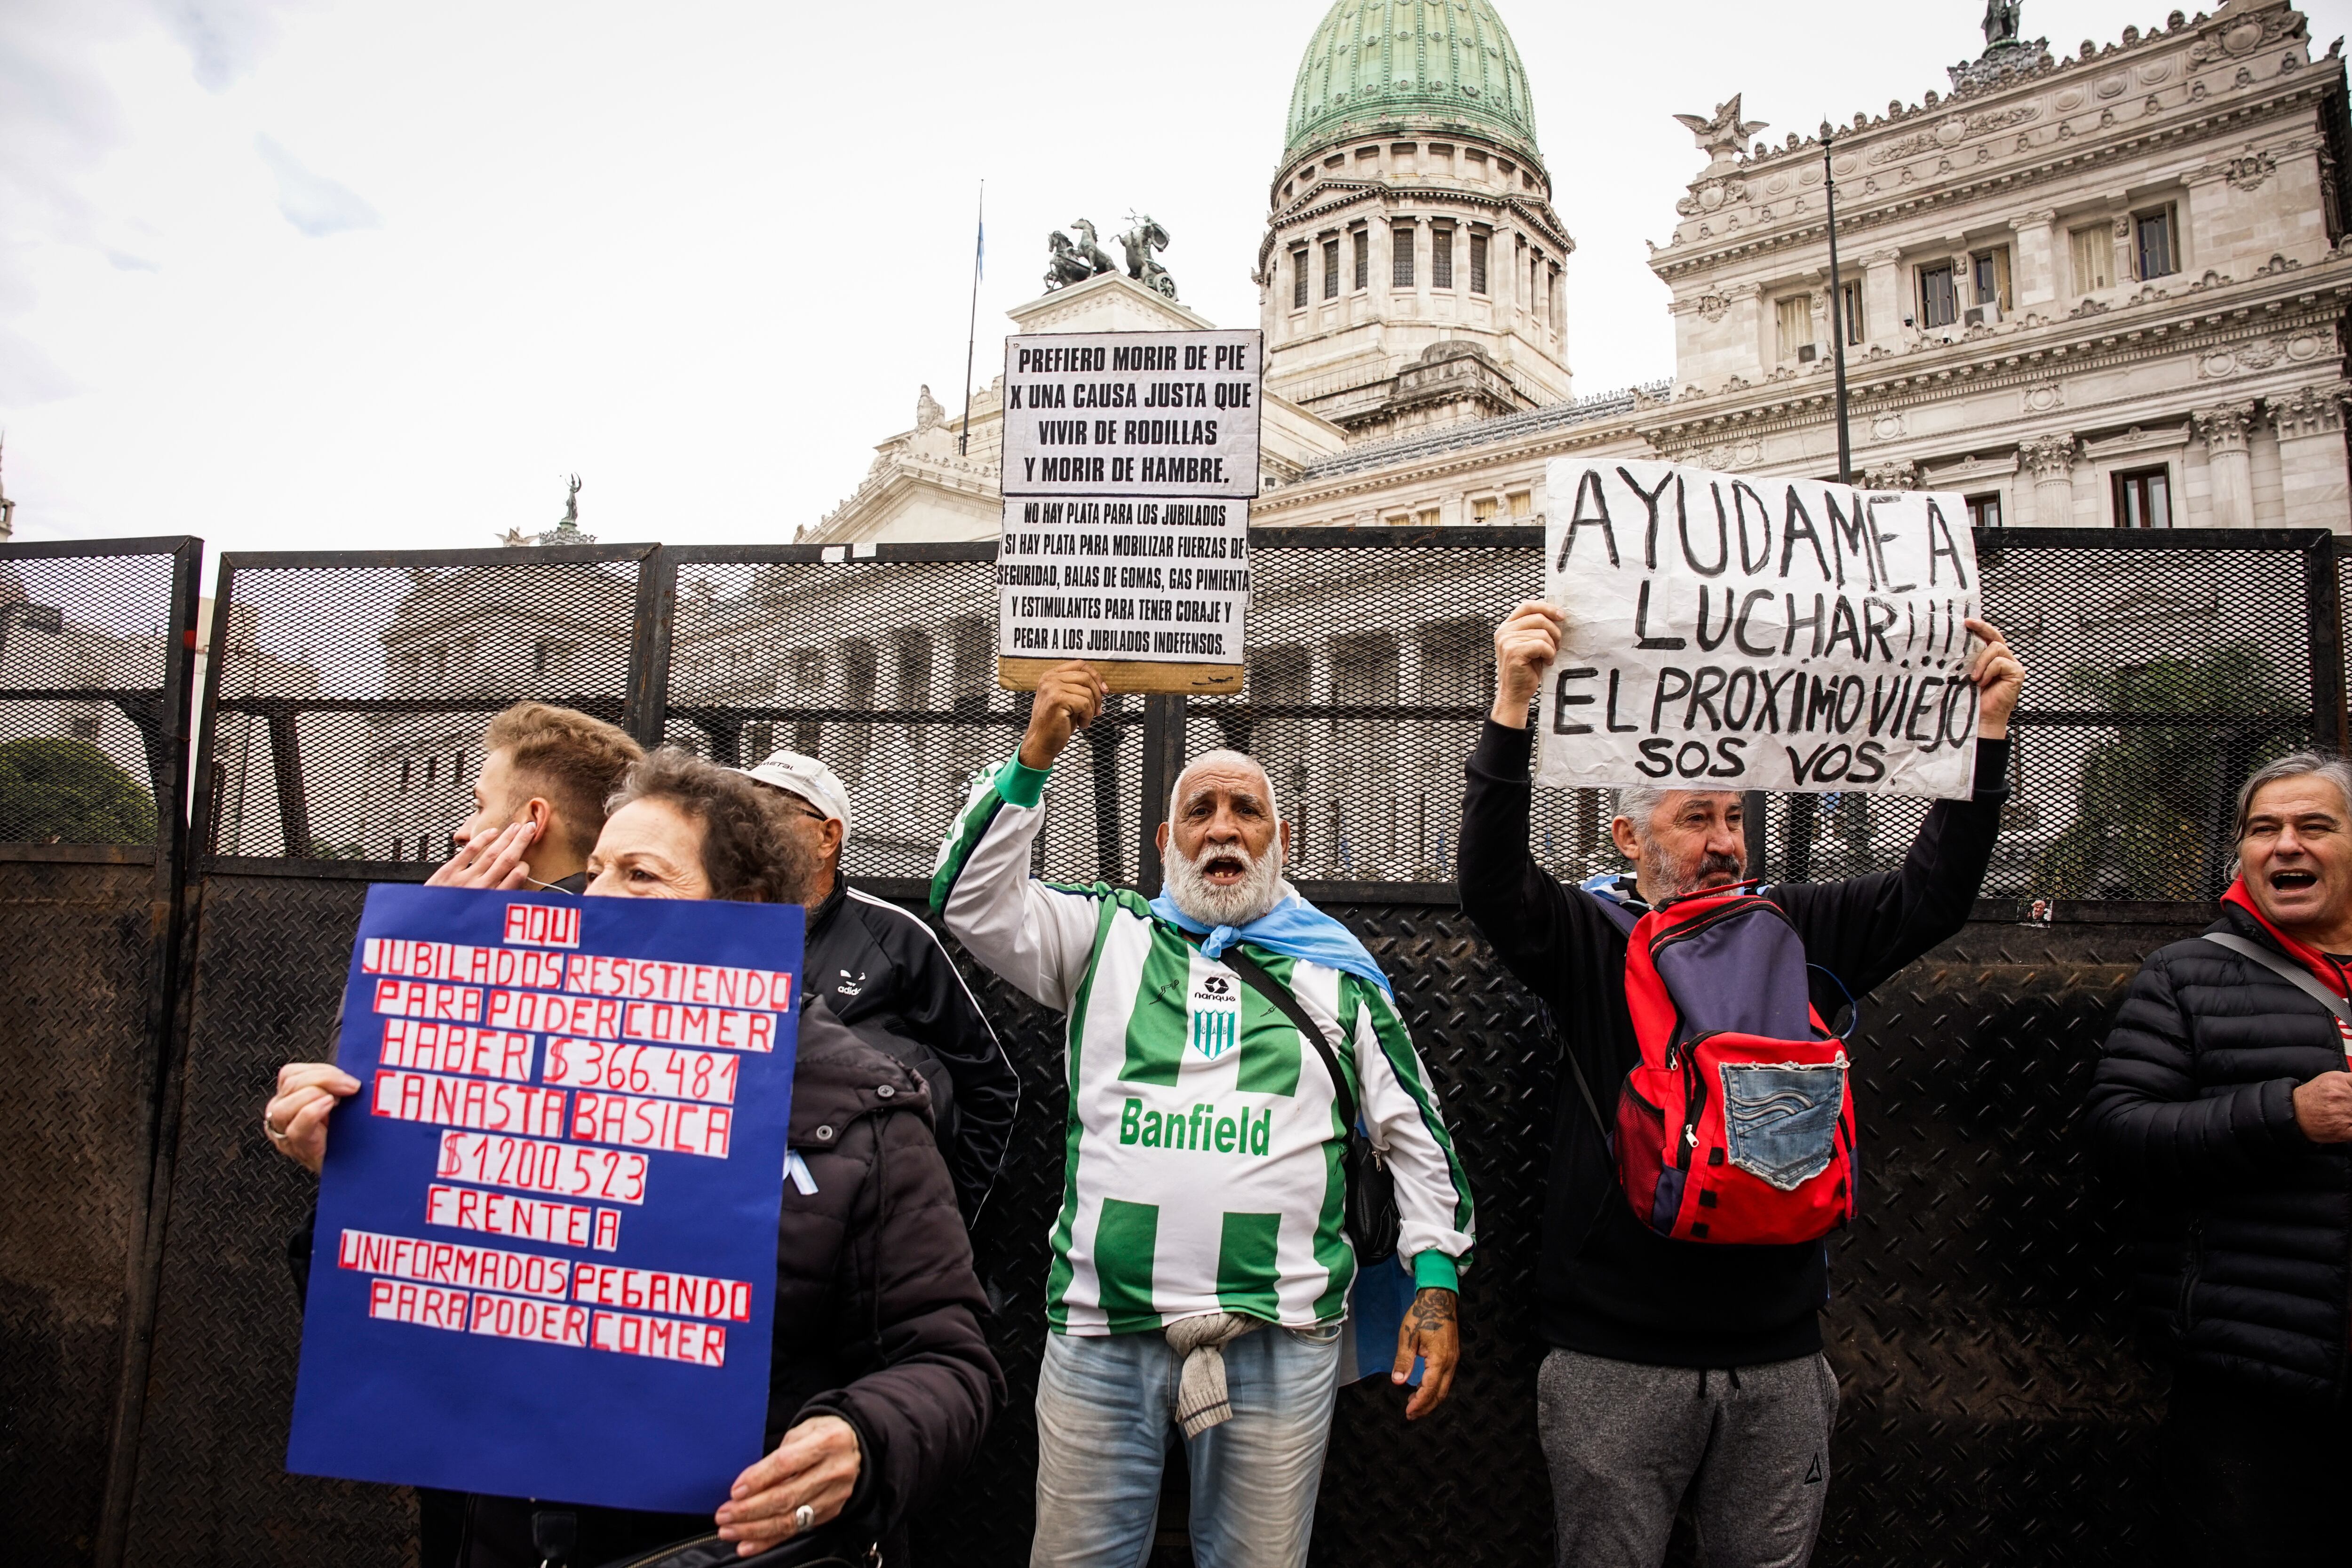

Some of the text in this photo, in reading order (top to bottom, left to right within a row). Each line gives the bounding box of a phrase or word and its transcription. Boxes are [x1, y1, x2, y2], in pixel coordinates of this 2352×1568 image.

[1019, 345, 1245, 373] PREFIERO MORIR DE PIE
[1010, 383, 1251, 411] X UNA CAUSA JUSTA QUE
[1039, 420, 1217, 445] VIVIR DE RODILLAS
[1025, 457, 1229, 483] Y MORIR DE HAMBRE.
[1025, 503, 1225, 526] NO HAY PLATA PARA LOS JUBILADOS
[1556, 466, 1966, 593] AYUDAME A
[1005, 534, 1244, 559] SI HAY PLATA PARA MOBILIZAR FUERZAS DE
[997, 565, 1249, 592] SEGURIDAD, BALAS DE GOMAS, GAS PIMIENTA
[1012, 597, 1231, 622] Y ESTIMULANTES PARA TENER CORAJE Y
[1014, 628, 1225, 654] PEGAR A LOS JUBILADOS INDEFENSOS.
[1554, 668, 1638, 735] EL
[1651, 666, 1865, 734] PROXIMO
[1635, 737, 1896, 786] SOS VOS.
[506, 905, 580, 946] AQUI
[362, 939, 791, 1011] JUBILADOS RESISTIENDO
[1194, 992, 1236, 1003] nanque
[374, 980, 774, 1051] PARA PODER COMER
[380, 1019, 533, 1080] HABER
[371, 1070, 731, 1156] CANASTA BASICA
[1120, 1098, 1271, 1156] Banfield
[439, 1134, 645, 1201] $1.200.523
[427, 1184, 619, 1250] FRENTE A
[340, 1231, 751, 1321] UNIFORMADOS PEGANDO
[370, 1279, 725, 1366] PARA PODER COMER
